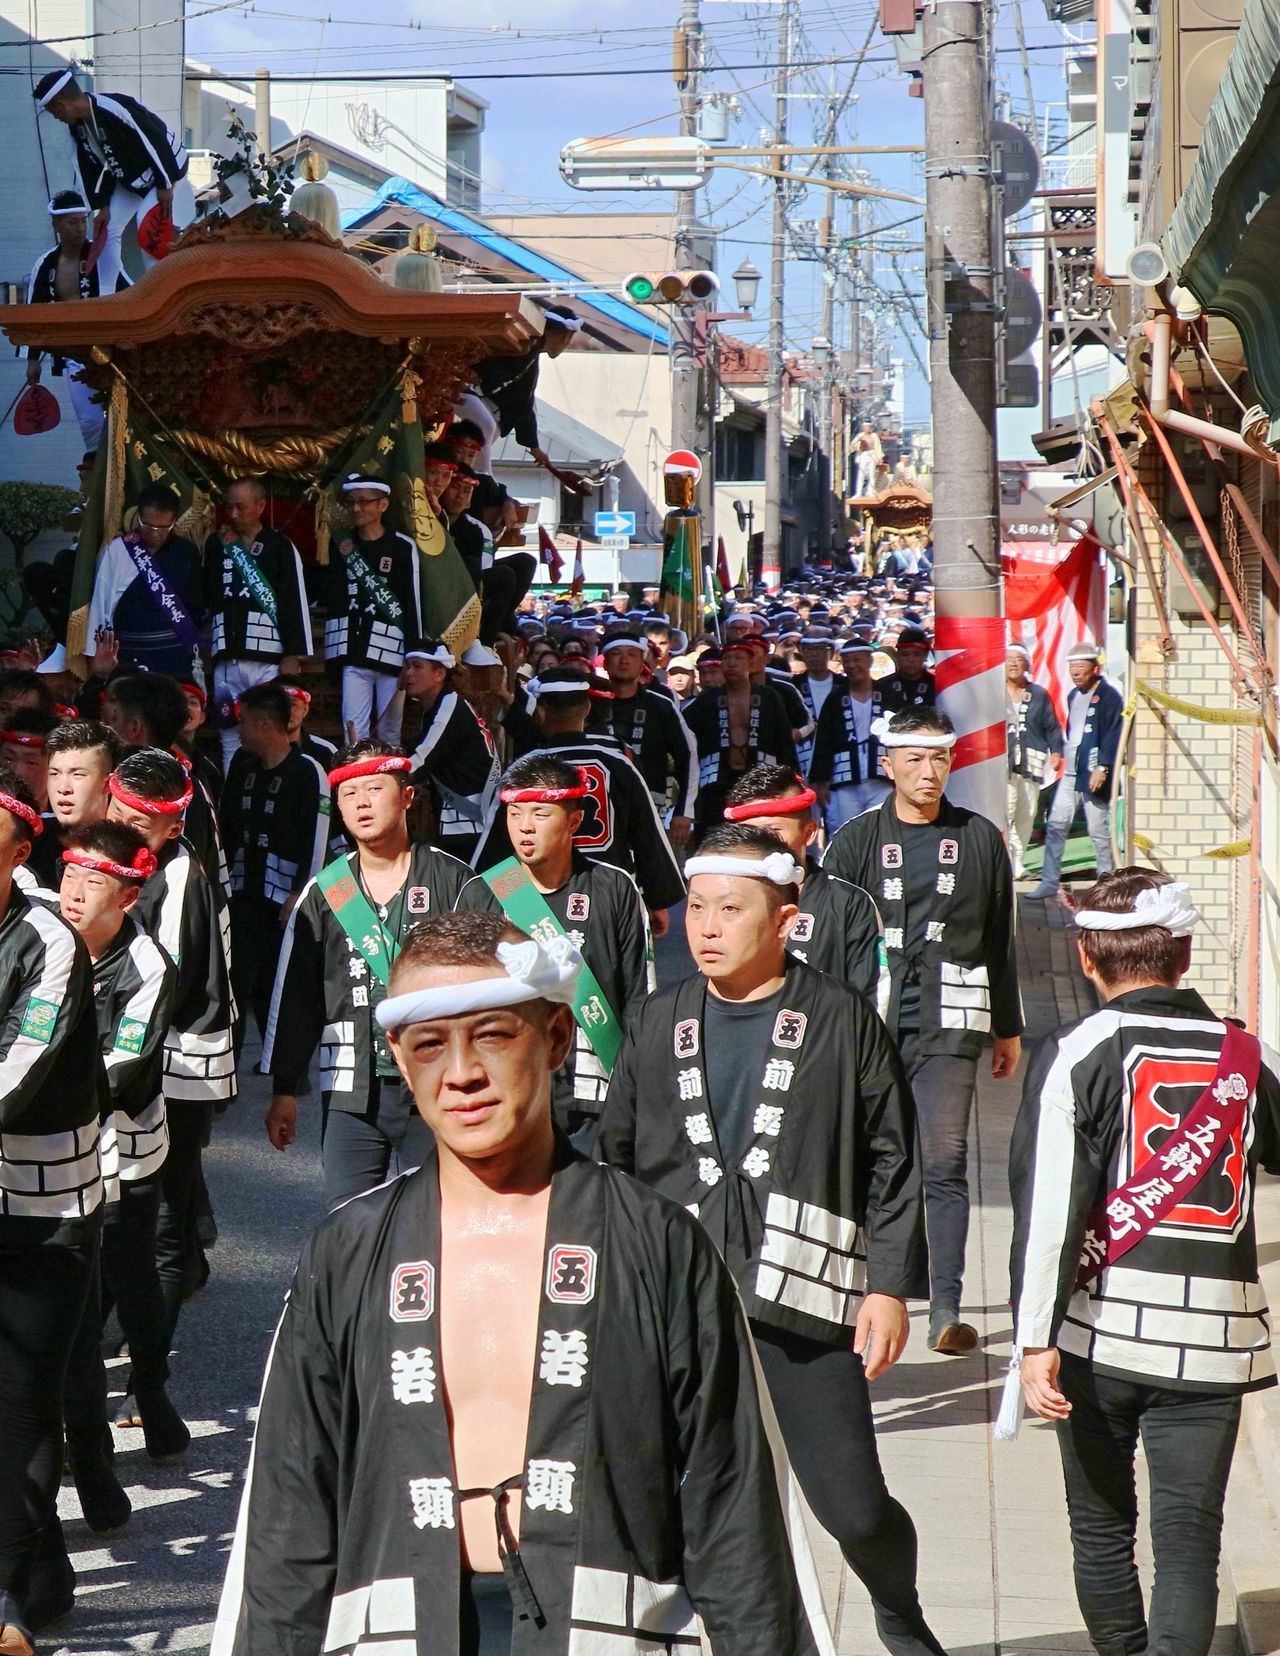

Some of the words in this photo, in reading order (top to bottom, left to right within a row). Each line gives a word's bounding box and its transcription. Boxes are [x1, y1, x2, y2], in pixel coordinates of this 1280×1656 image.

[133, 544, 185, 623] 五軒屋町会長
[883, 876, 904, 949] 若頭
[390, 1346, 456, 1530] 若頭
[524, 1329, 591, 1515] 若頭
